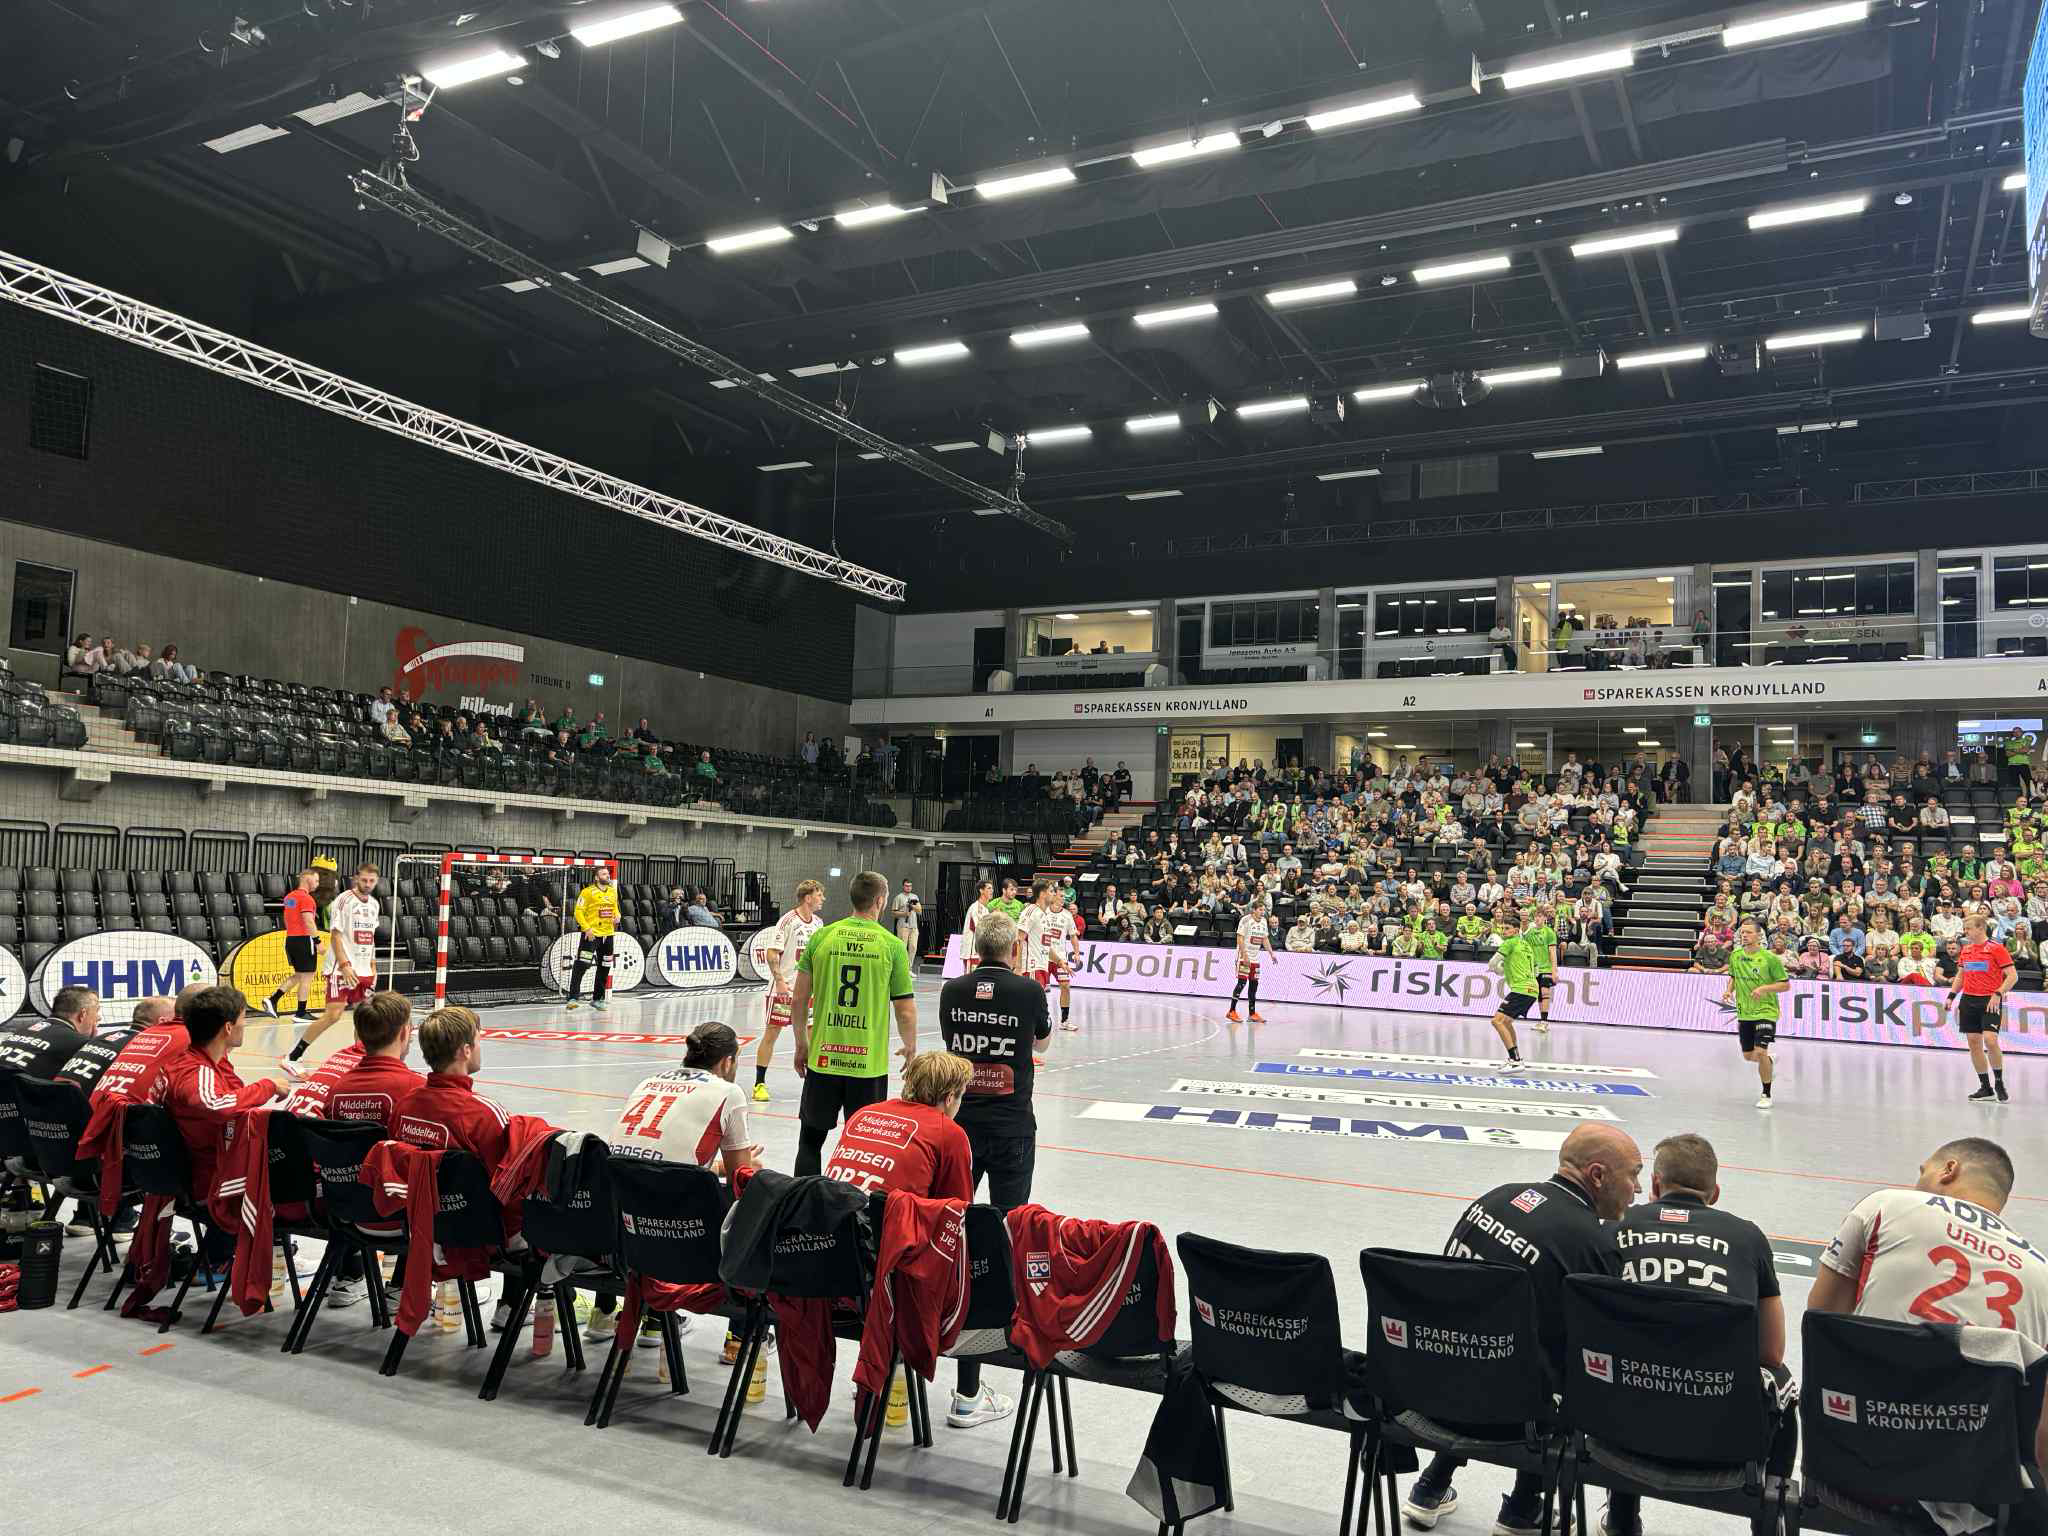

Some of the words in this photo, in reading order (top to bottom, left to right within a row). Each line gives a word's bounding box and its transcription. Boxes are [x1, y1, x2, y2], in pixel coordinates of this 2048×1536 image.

[1402, 695, 1416, 707] A2
[1597, 685, 1704, 700] SPAREKASSEN
[1710, 682, 1826, 698] KRONJYLLAND
[984, 707, 995, 719] A1
[1083, 702, 1162, 714] SPAREKASSEN
[1165, 699, 1249, 712] KRONJYLLAND
[665, 944, 722, 972] HHM
[61, 958, 186, 999] HHM
[245, 973, 271, 986] ALLAN
[837, 964, 862, 1008] 8
[827, 1012, 868, 1030] LINDELL
[950, 1007, 1019, 1028] thansen
[951, 1032, 990, 1054] ADP
[339, 1100, 383, 1110] Middelfart
[1364, 1096, 1583, 1117] NIELSEN
[620, 1093, 678, 1140] 41
[861, 1115, 908, 1131] Middelfart
[1143, 1104, 1470, 1141] HHM
[401, 1122, 441, 1141] Middelfart
[608, 1141, 664, 1161] hansen
[636, 1215, 704, 1230] SPAREKASSEN
[1925, 1195, 2002, 1232] ADP
[639, 1225, 706, 1240] KRONJYLLAND
[1466, 1203, 1541, 1265] thansen
[1616, 1228, 1730, 1257] thansen
[774, 1238, 837, 1254] ONJYLLAND
[1946, 1221, 2023, 1270] URIOS
[1621, 1257, 1685, 1284] ADP
[1907, 1244, 2024, 1330] 23
[1217, 1307, 1310, 1329] SPAREKASSEN
[1219, 1320, 1308, 1341] KRONJYLLAND
[1413, 1324, 1514, 1347] SPAREKASSEN
[1414, 1340, 1514, 1361] KRONJYLLAND
[1620, 1358, 1735, 1385] SPAREKASSEN
[1621, 1373, 1733, 1398] KRONJYLLAND
[1865, 1398, 1990, 1420] SPAREKASSEN
[1866, 1413, 1986, 1433] KRONJYLLAND
